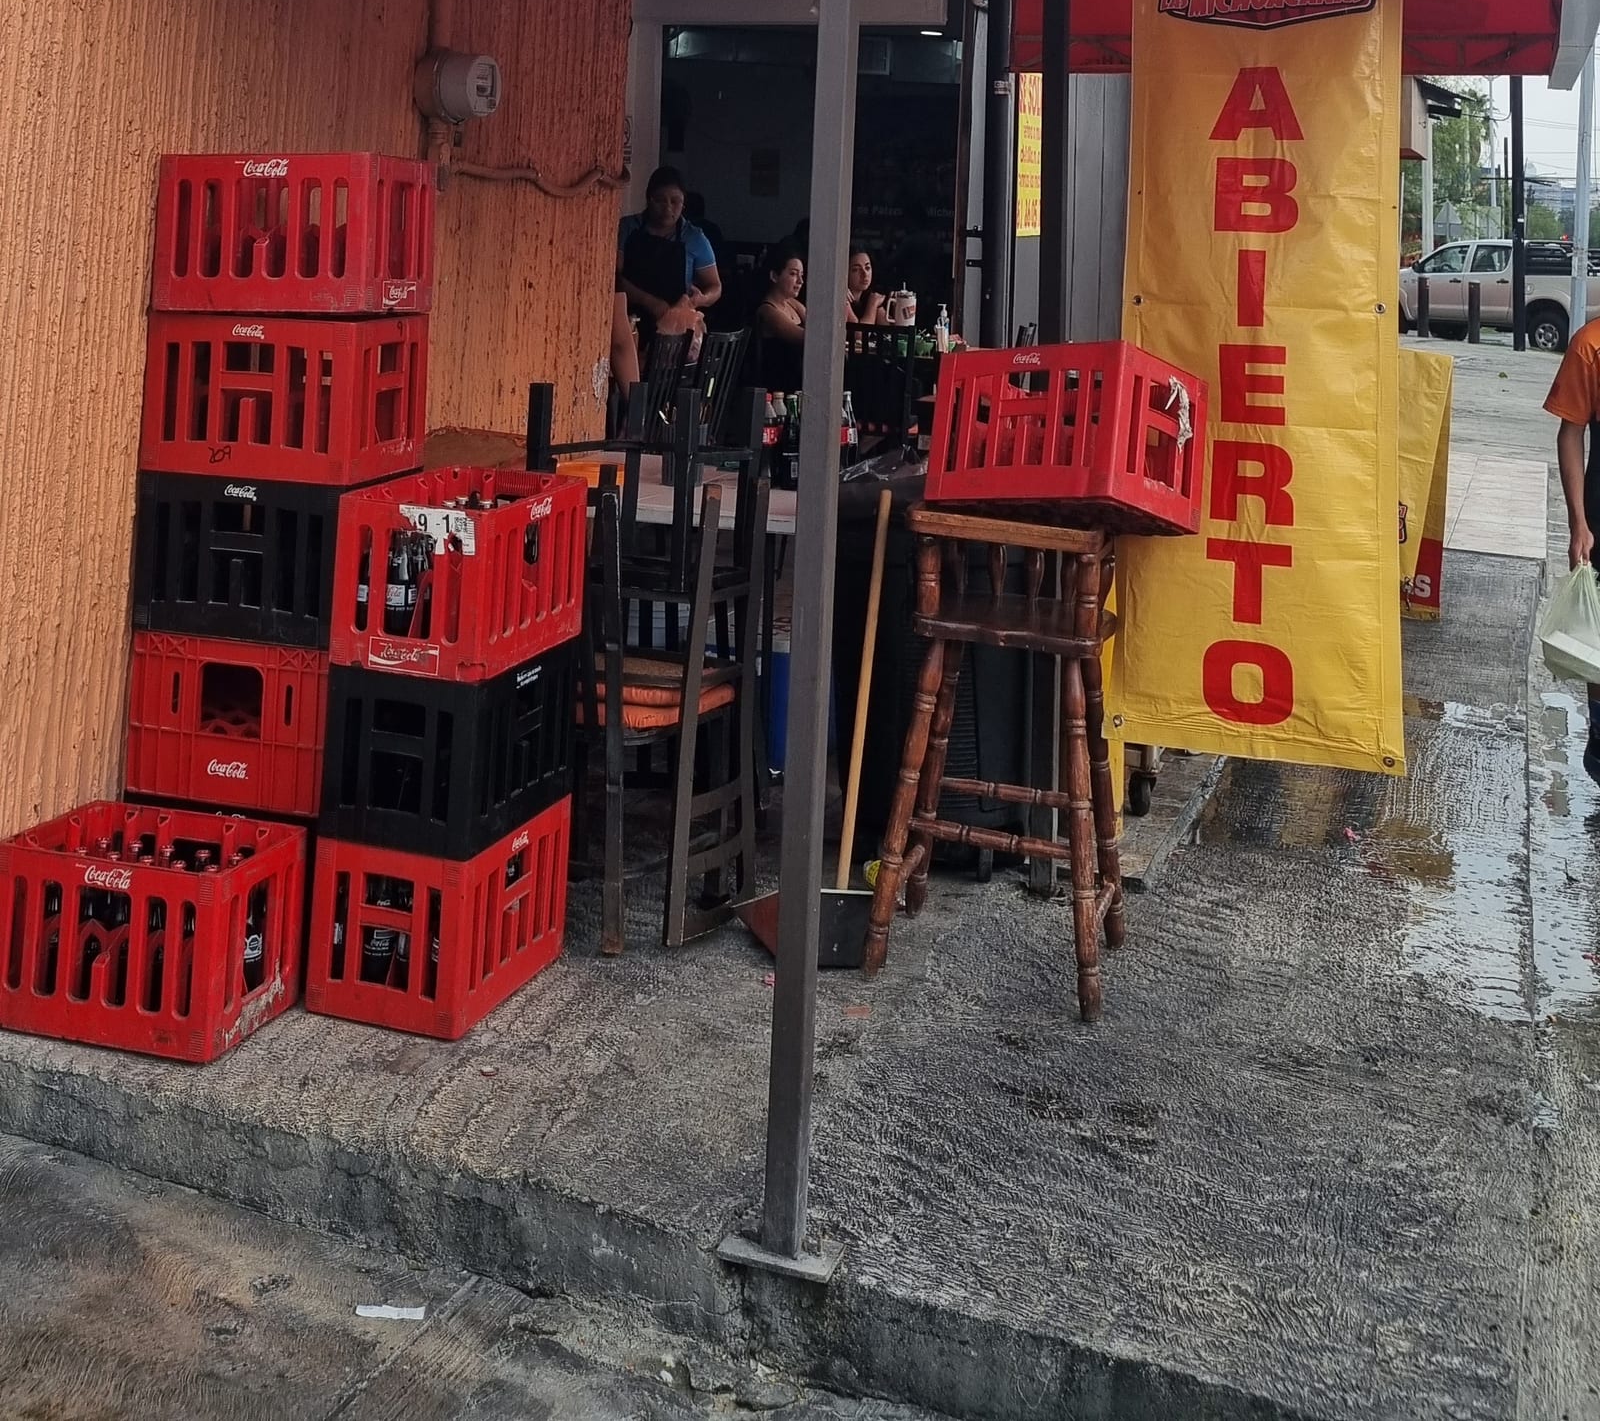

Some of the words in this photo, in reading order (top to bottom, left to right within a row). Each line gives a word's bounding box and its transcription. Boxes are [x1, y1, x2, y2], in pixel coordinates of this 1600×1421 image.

[243, 158, 289, 177] Coca-Cola
[232, 324, 264, 339] Coca-Cola
[1013, 352, 1041, 365] Coca-Cola
[1202, 66, 1305, 726] ABIERTO
[224, 484, 257, 501] Coca-Cola
[207, 759, 248, 779] Coca-Cola
[85, 865, 133, 890] Coca-Cola
